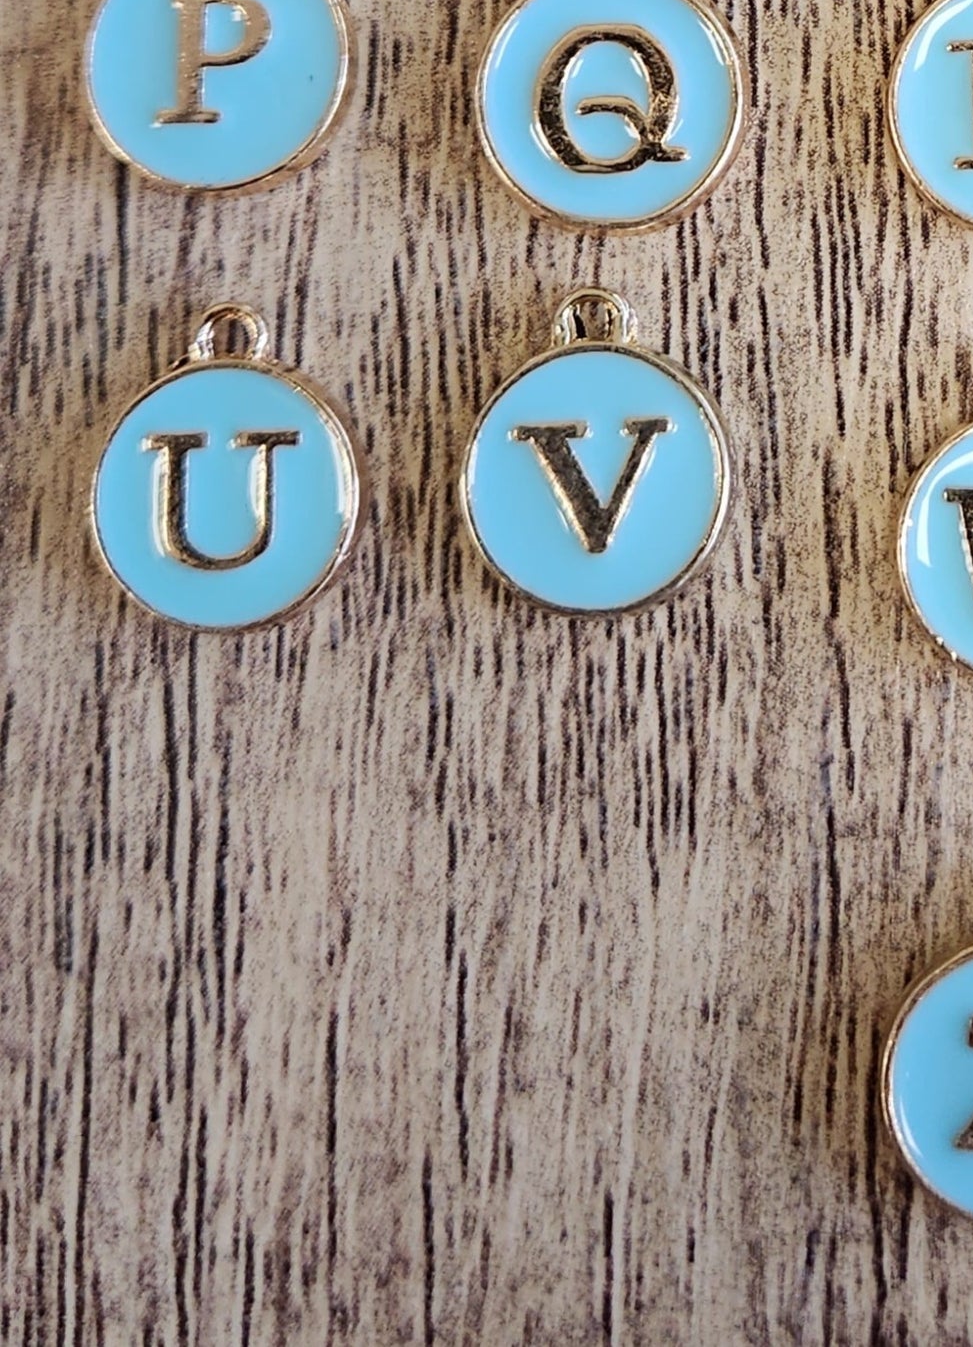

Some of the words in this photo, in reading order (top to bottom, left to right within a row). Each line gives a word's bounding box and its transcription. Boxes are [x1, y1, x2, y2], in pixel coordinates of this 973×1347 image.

[532, 23, 690, 172] Q
[140, 430, 303, 572] U
[509, 418, 670, 556] V
